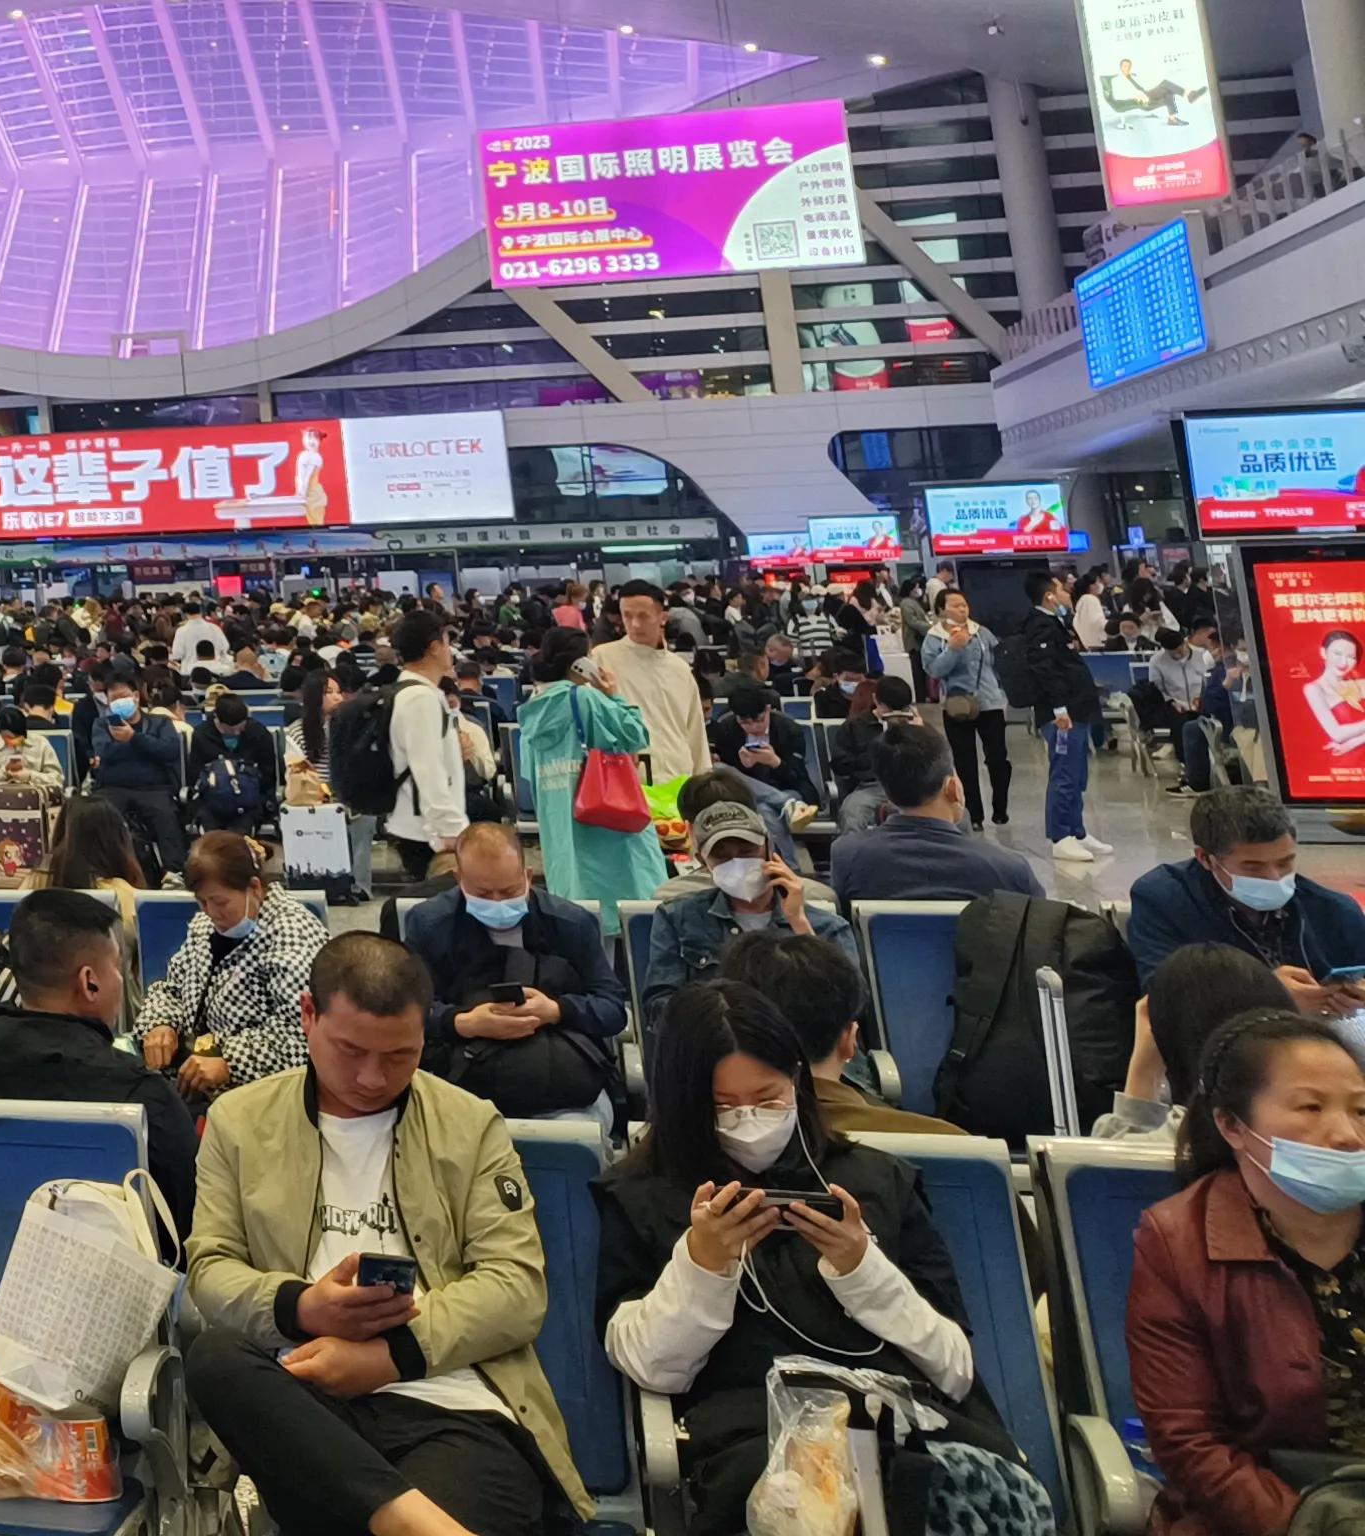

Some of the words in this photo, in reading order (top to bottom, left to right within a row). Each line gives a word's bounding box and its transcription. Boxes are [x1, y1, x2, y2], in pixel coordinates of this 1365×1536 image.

[514, 135, 551, 150] 2023
[488, 136, 794, 187] 宁波国际照明展览会
[502, 196, 608, 222] 5月8-10日
[500, 256, 601, 280] 021-6296
[605, 253, 660, 273] 3333
[1240, 451, 1337, 474] 品质优选
